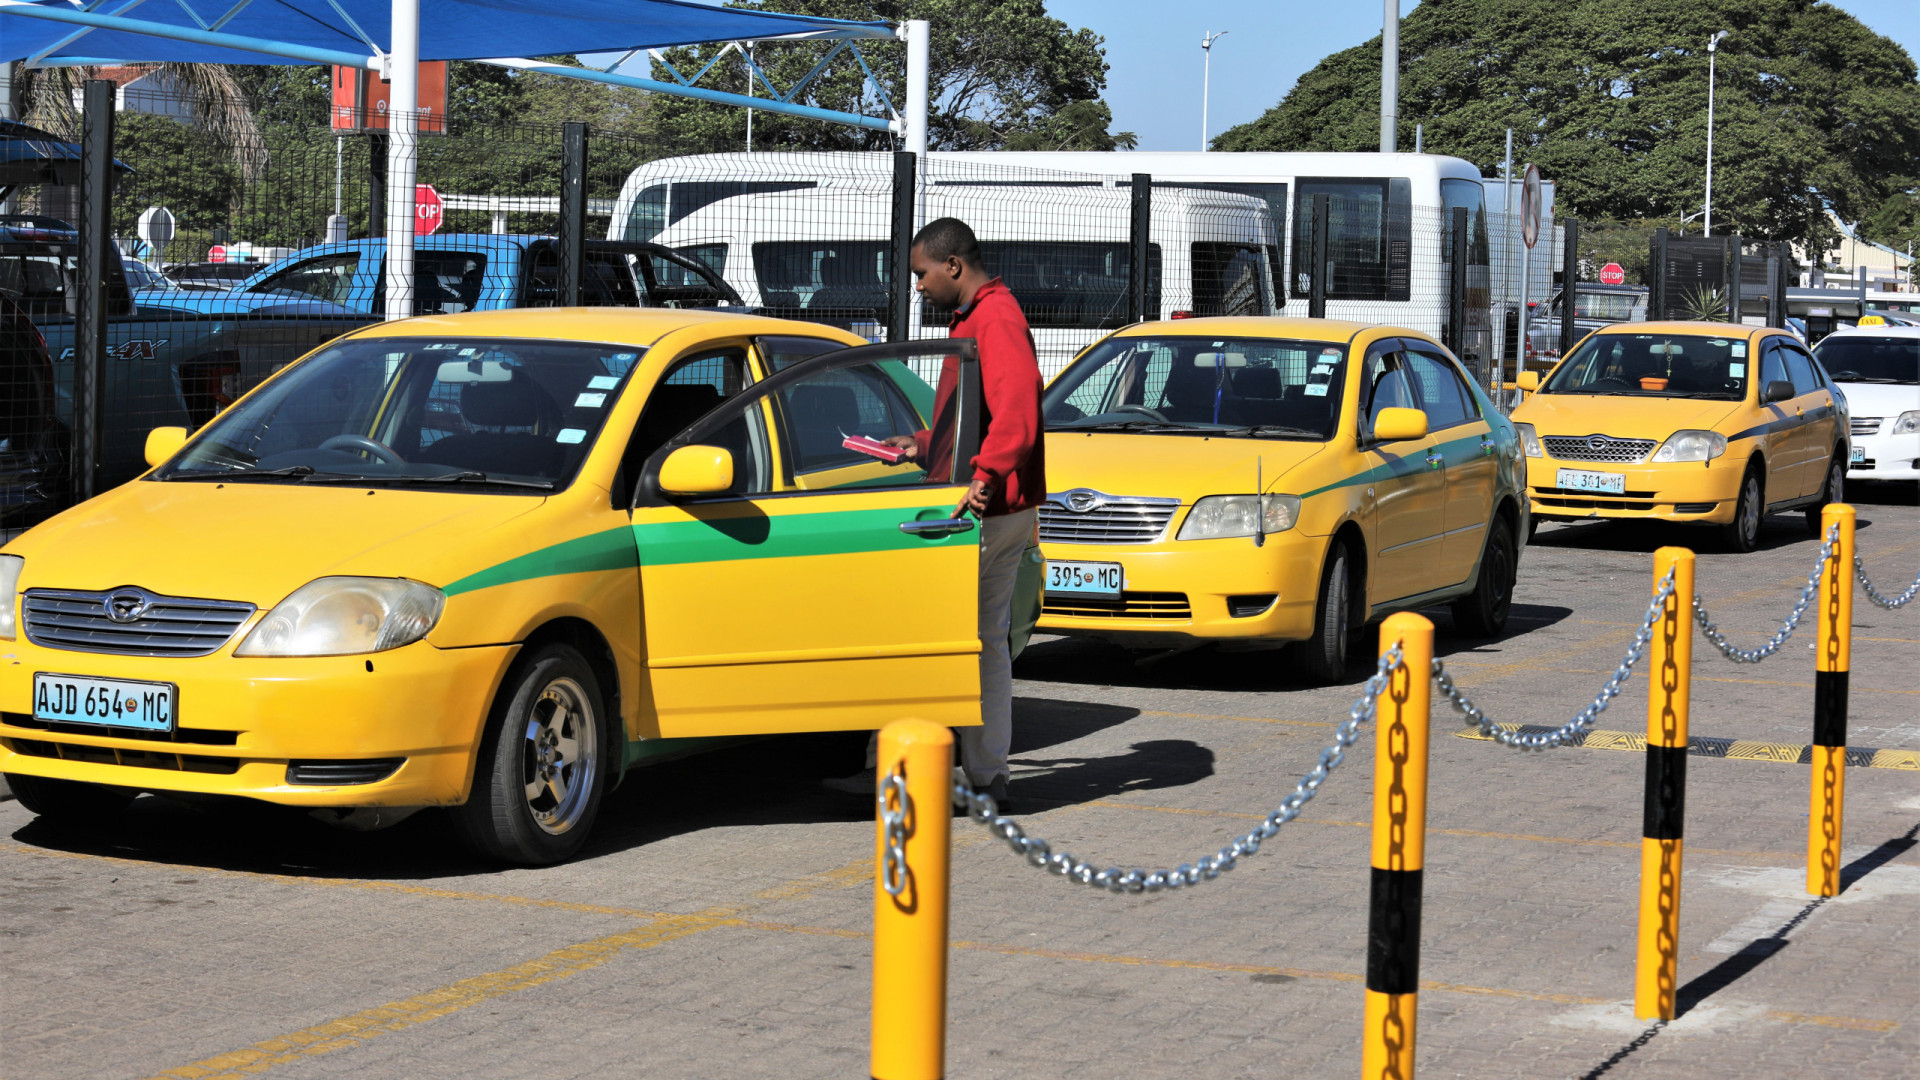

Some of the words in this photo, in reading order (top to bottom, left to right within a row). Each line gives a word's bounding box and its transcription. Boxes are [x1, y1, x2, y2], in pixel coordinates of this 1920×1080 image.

[416, 203, 439, 219] OP
[1602, 271, 1622, 280] STOP
[1581, 474, 1600, 488] 381
[1051, 566, 1082, 588] 395
[1098, 568, 1118, 589] MC
[37, 682, 77, 715] AJD
[85, 686, 123, 719] 654
[143, 690, 168, 723] MC
